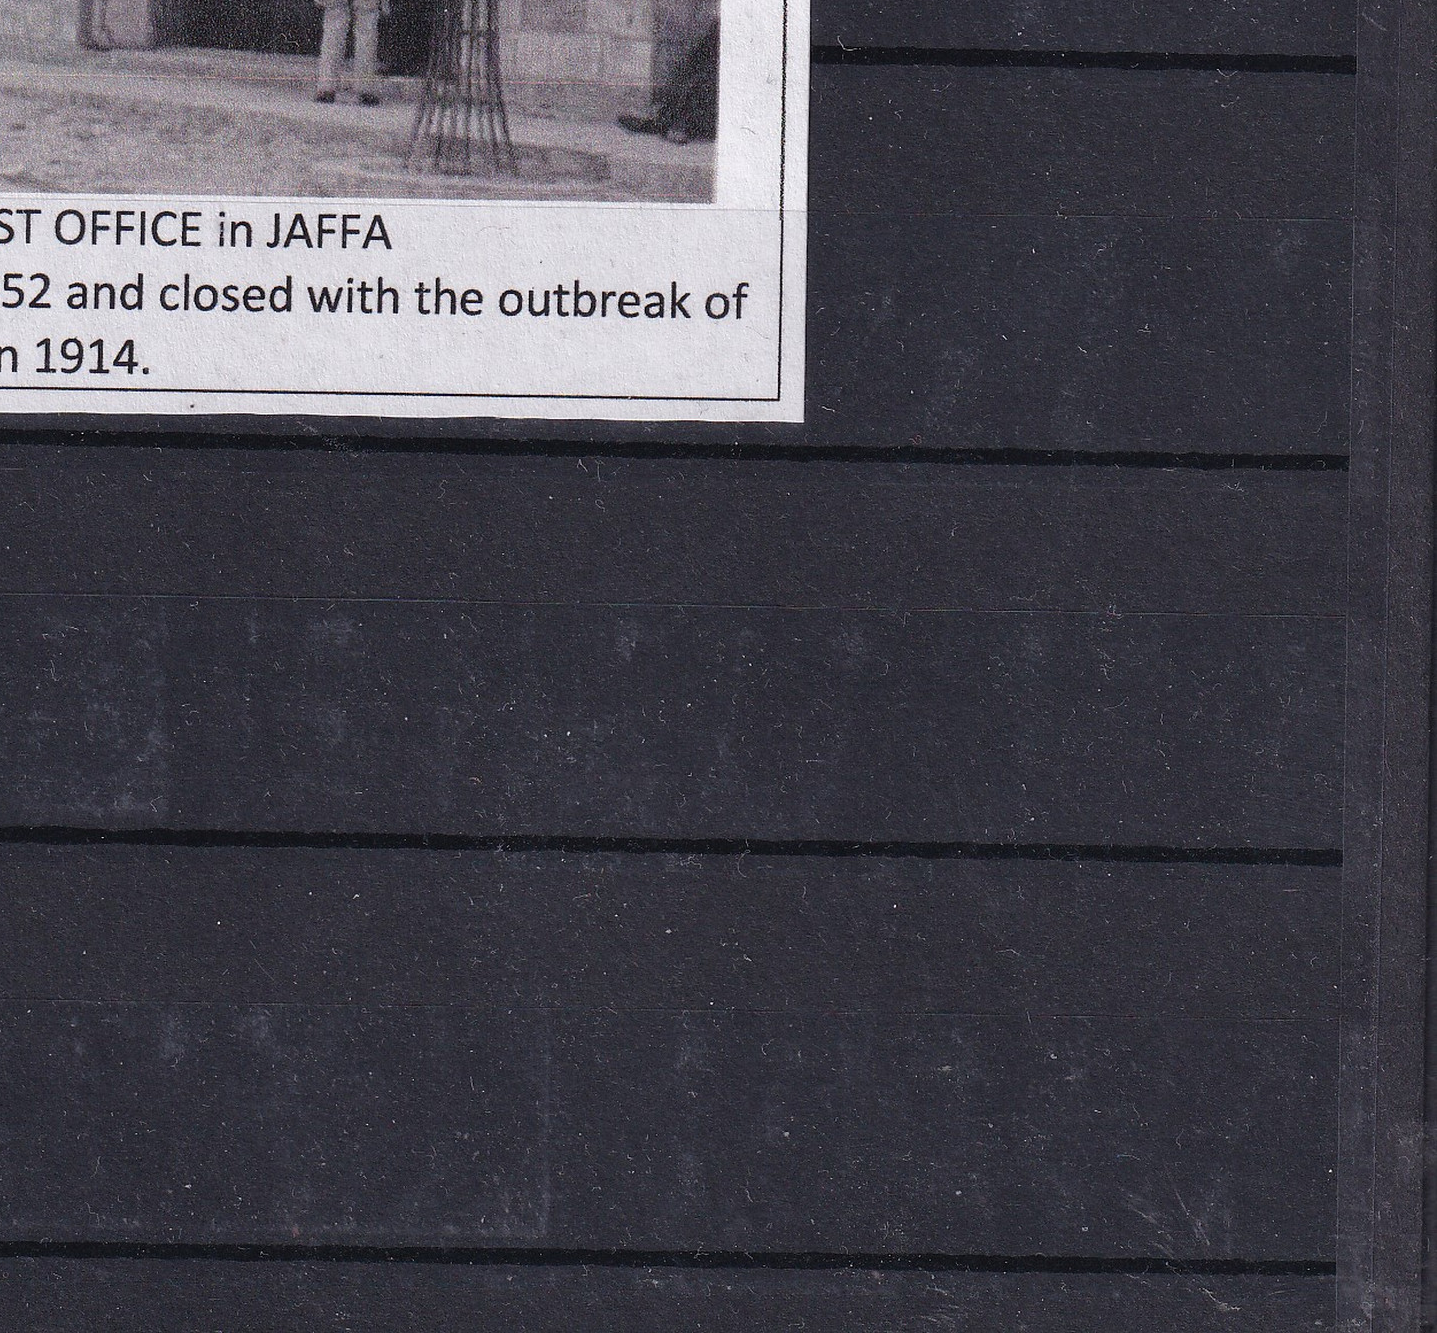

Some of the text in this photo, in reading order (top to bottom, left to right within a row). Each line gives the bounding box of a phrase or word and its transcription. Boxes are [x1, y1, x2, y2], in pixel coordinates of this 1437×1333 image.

[54, 208, 202, 247] OFFICE
[218, 211, 253, 248] in
[266, 212, 393, 250] JAFFA
[66, 272, 144, 311] and
[159, 273, 293, 313] closed
[306, 276, 400, 315] with
[414, 276, 484, 317] the
[498, 279, 692, 319] outbreak
[704, 282, 750, 320] of
[35, 337, 150, 375] 1914.
